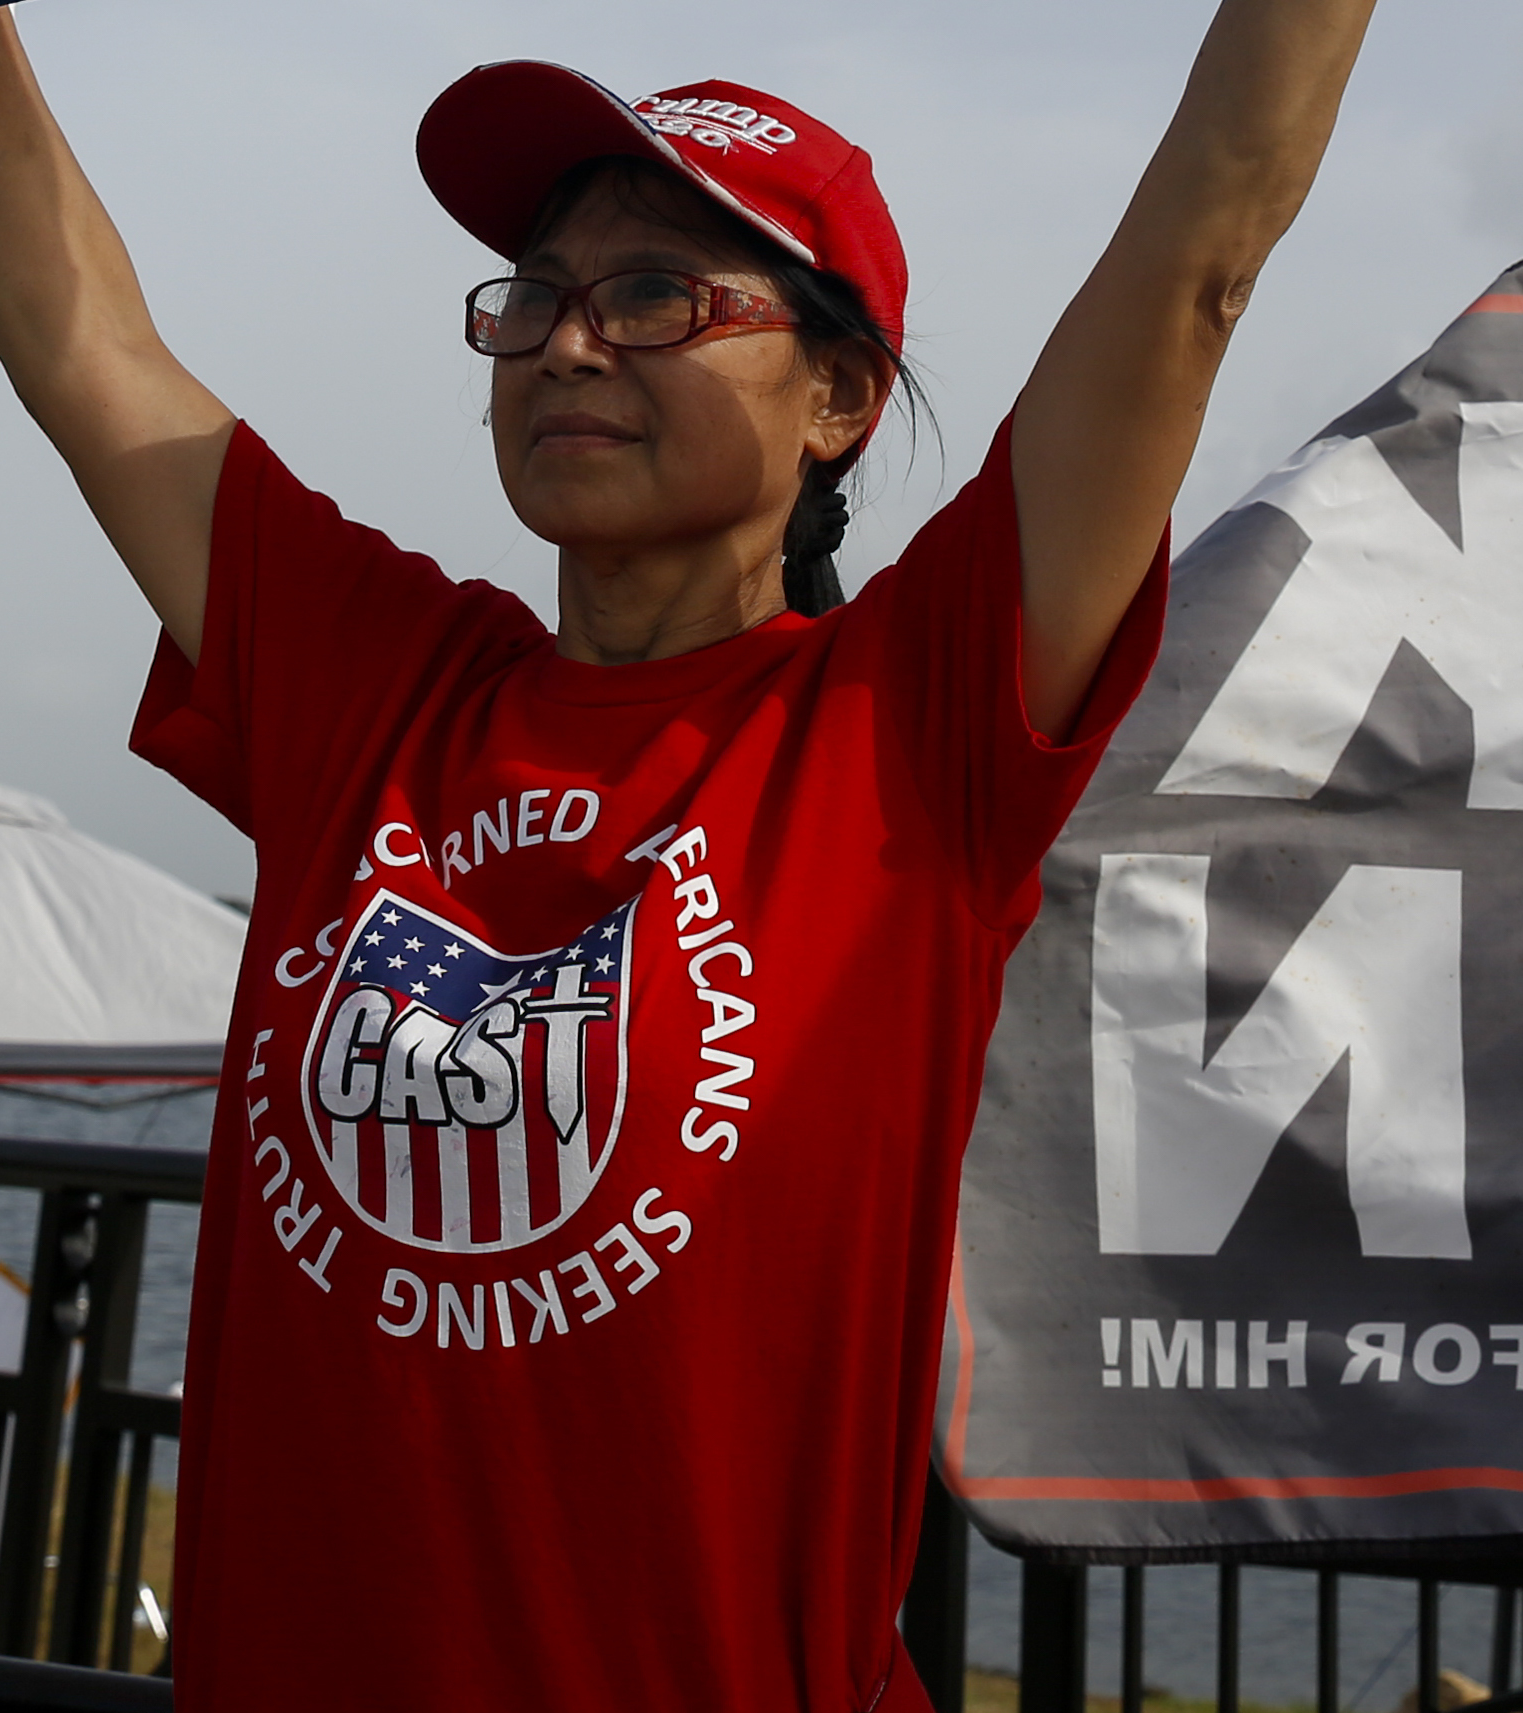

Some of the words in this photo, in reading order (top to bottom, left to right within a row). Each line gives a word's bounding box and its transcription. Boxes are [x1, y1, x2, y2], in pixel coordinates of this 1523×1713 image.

[628, 95, 797, 145] rump
[317, 960, 615, 1146] CAST
[246, 1028, 344, 1293] TRUTH
[377, 1187, 693, 1352] SEEKING
